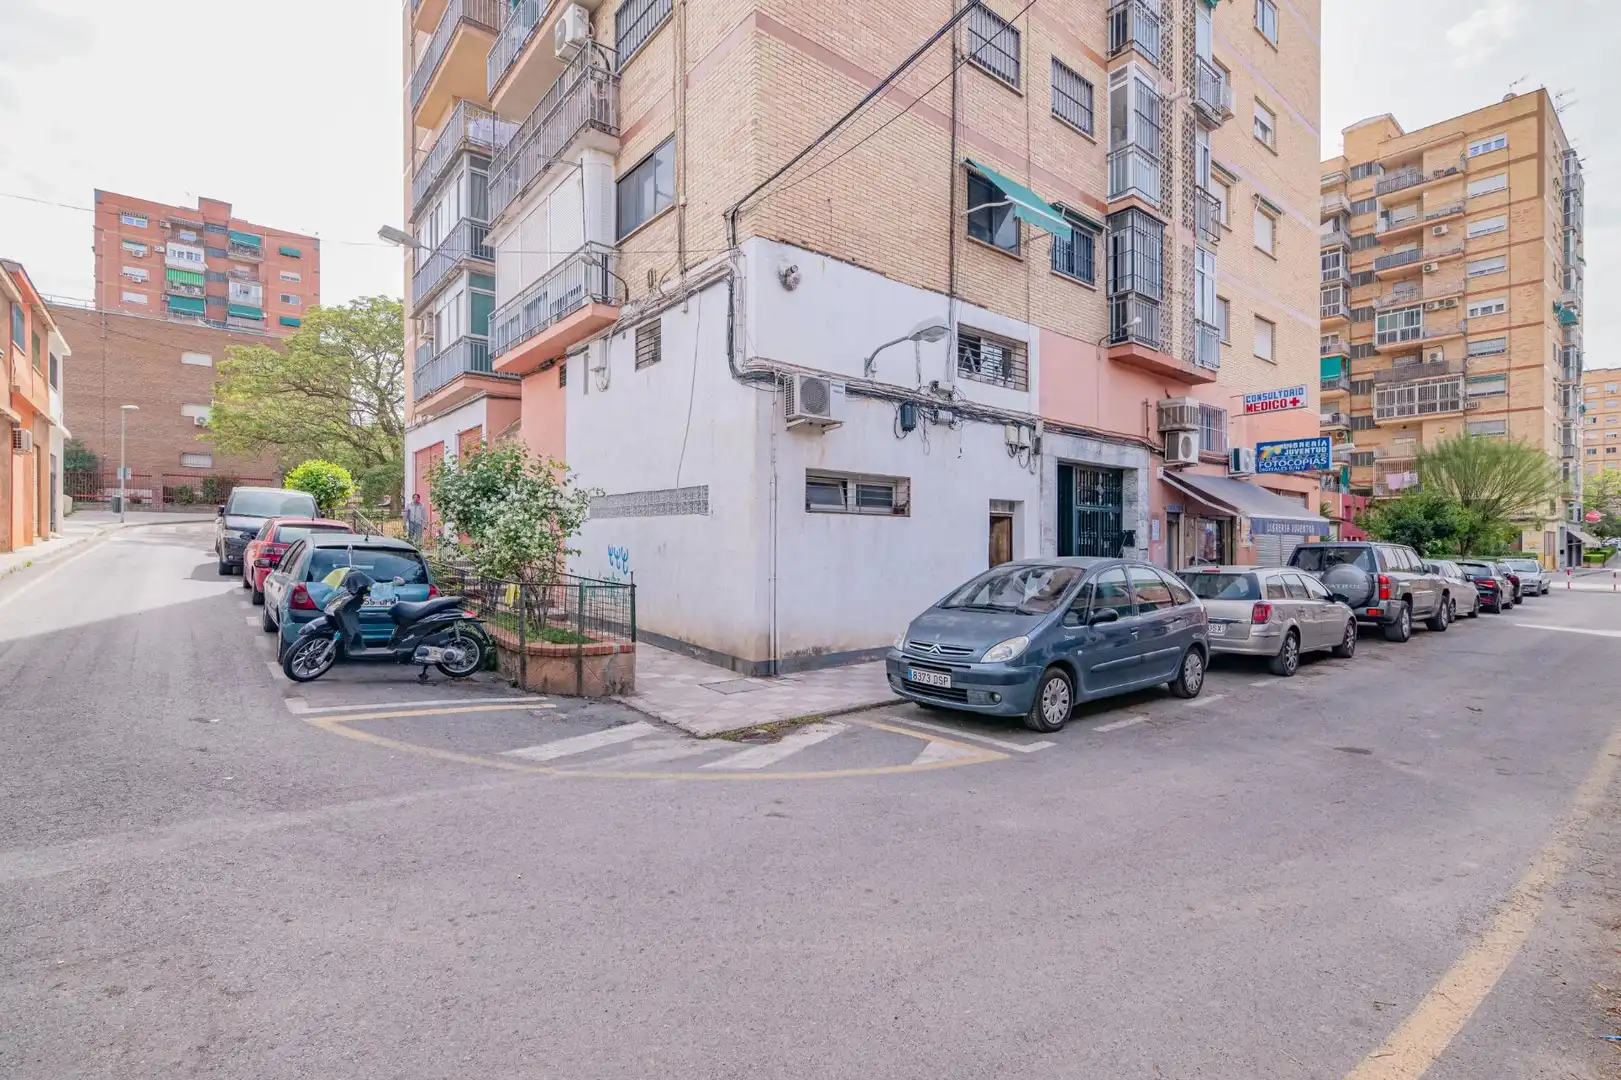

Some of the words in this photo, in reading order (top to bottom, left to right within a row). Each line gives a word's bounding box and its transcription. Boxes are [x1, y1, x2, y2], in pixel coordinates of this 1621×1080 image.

[1245, 387, 1304, 403] CONSULTORIO
[1246, 399, 1287, 413] MEDICO
[1284, 447, 1327, 456] JUVENTUD
[1259, 458, 1327, 468] FOTOCOPIAS
[912, 671, 931, 683] 8373
[933, 675, 949, 686] DSP
